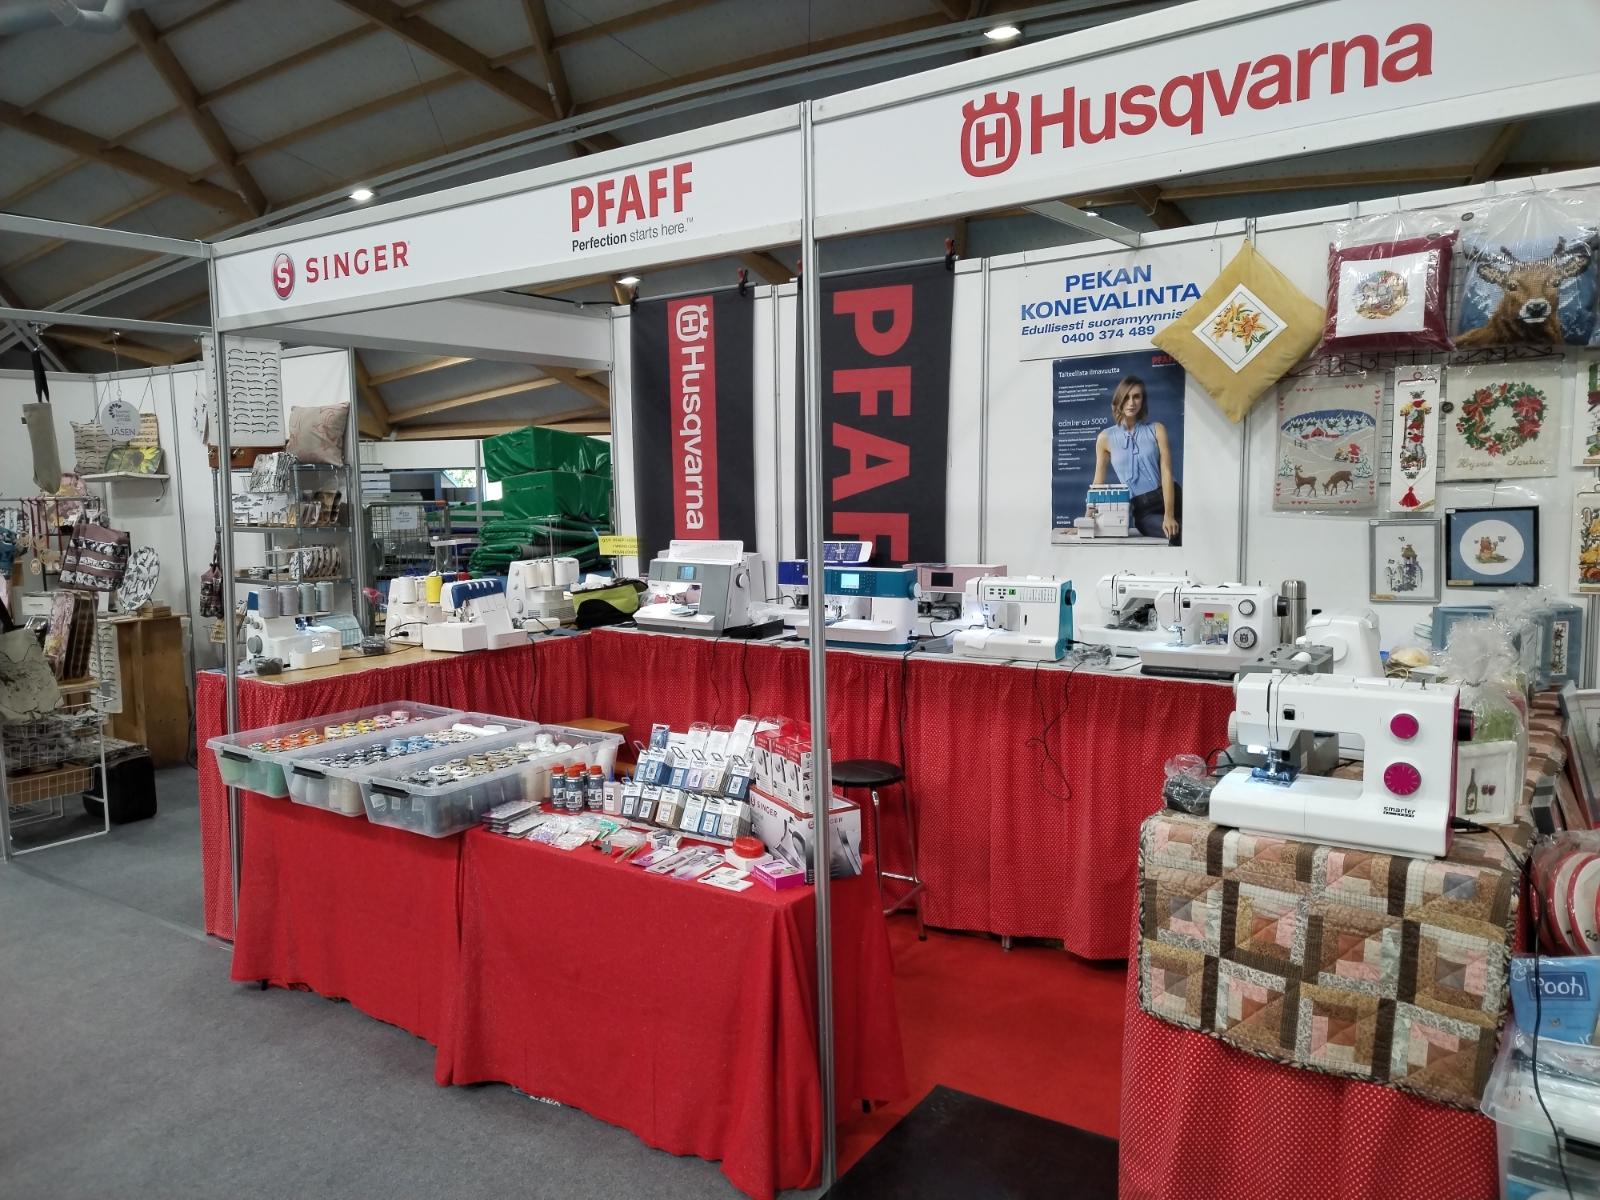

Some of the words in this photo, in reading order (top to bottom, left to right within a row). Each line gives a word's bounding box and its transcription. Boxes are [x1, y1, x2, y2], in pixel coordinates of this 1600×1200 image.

[1031, 22, 1433, 155] Husqvarna
[570, 161, 693, 233] PFAFF
[572, 233, 627, 252] Perfection
[629, 226, 659, 242] starts
[305, 240, 409, 283] SINGER
[1065, 264, 1152, 293] PEKAN
[1021, 282, 1202, 321] KONEVALINTA
[1021, 319, 1085, 336] Edullisesti
[1087, 308, 1188, 330] suoramyynnis
[1061, 332, 1095, 344] 0400
[1098, 329, 1125, 341] 374
[1128, 325, 1156, 337] 489
[110, 426, 136, 436] JÄSEN
[679, 345, 705, 530] Husqvarna
[832, 284, 913, 562] PFAF
[757, 801, 778, 818] SINGER
[1383, 806, 1416, 815] smarter
